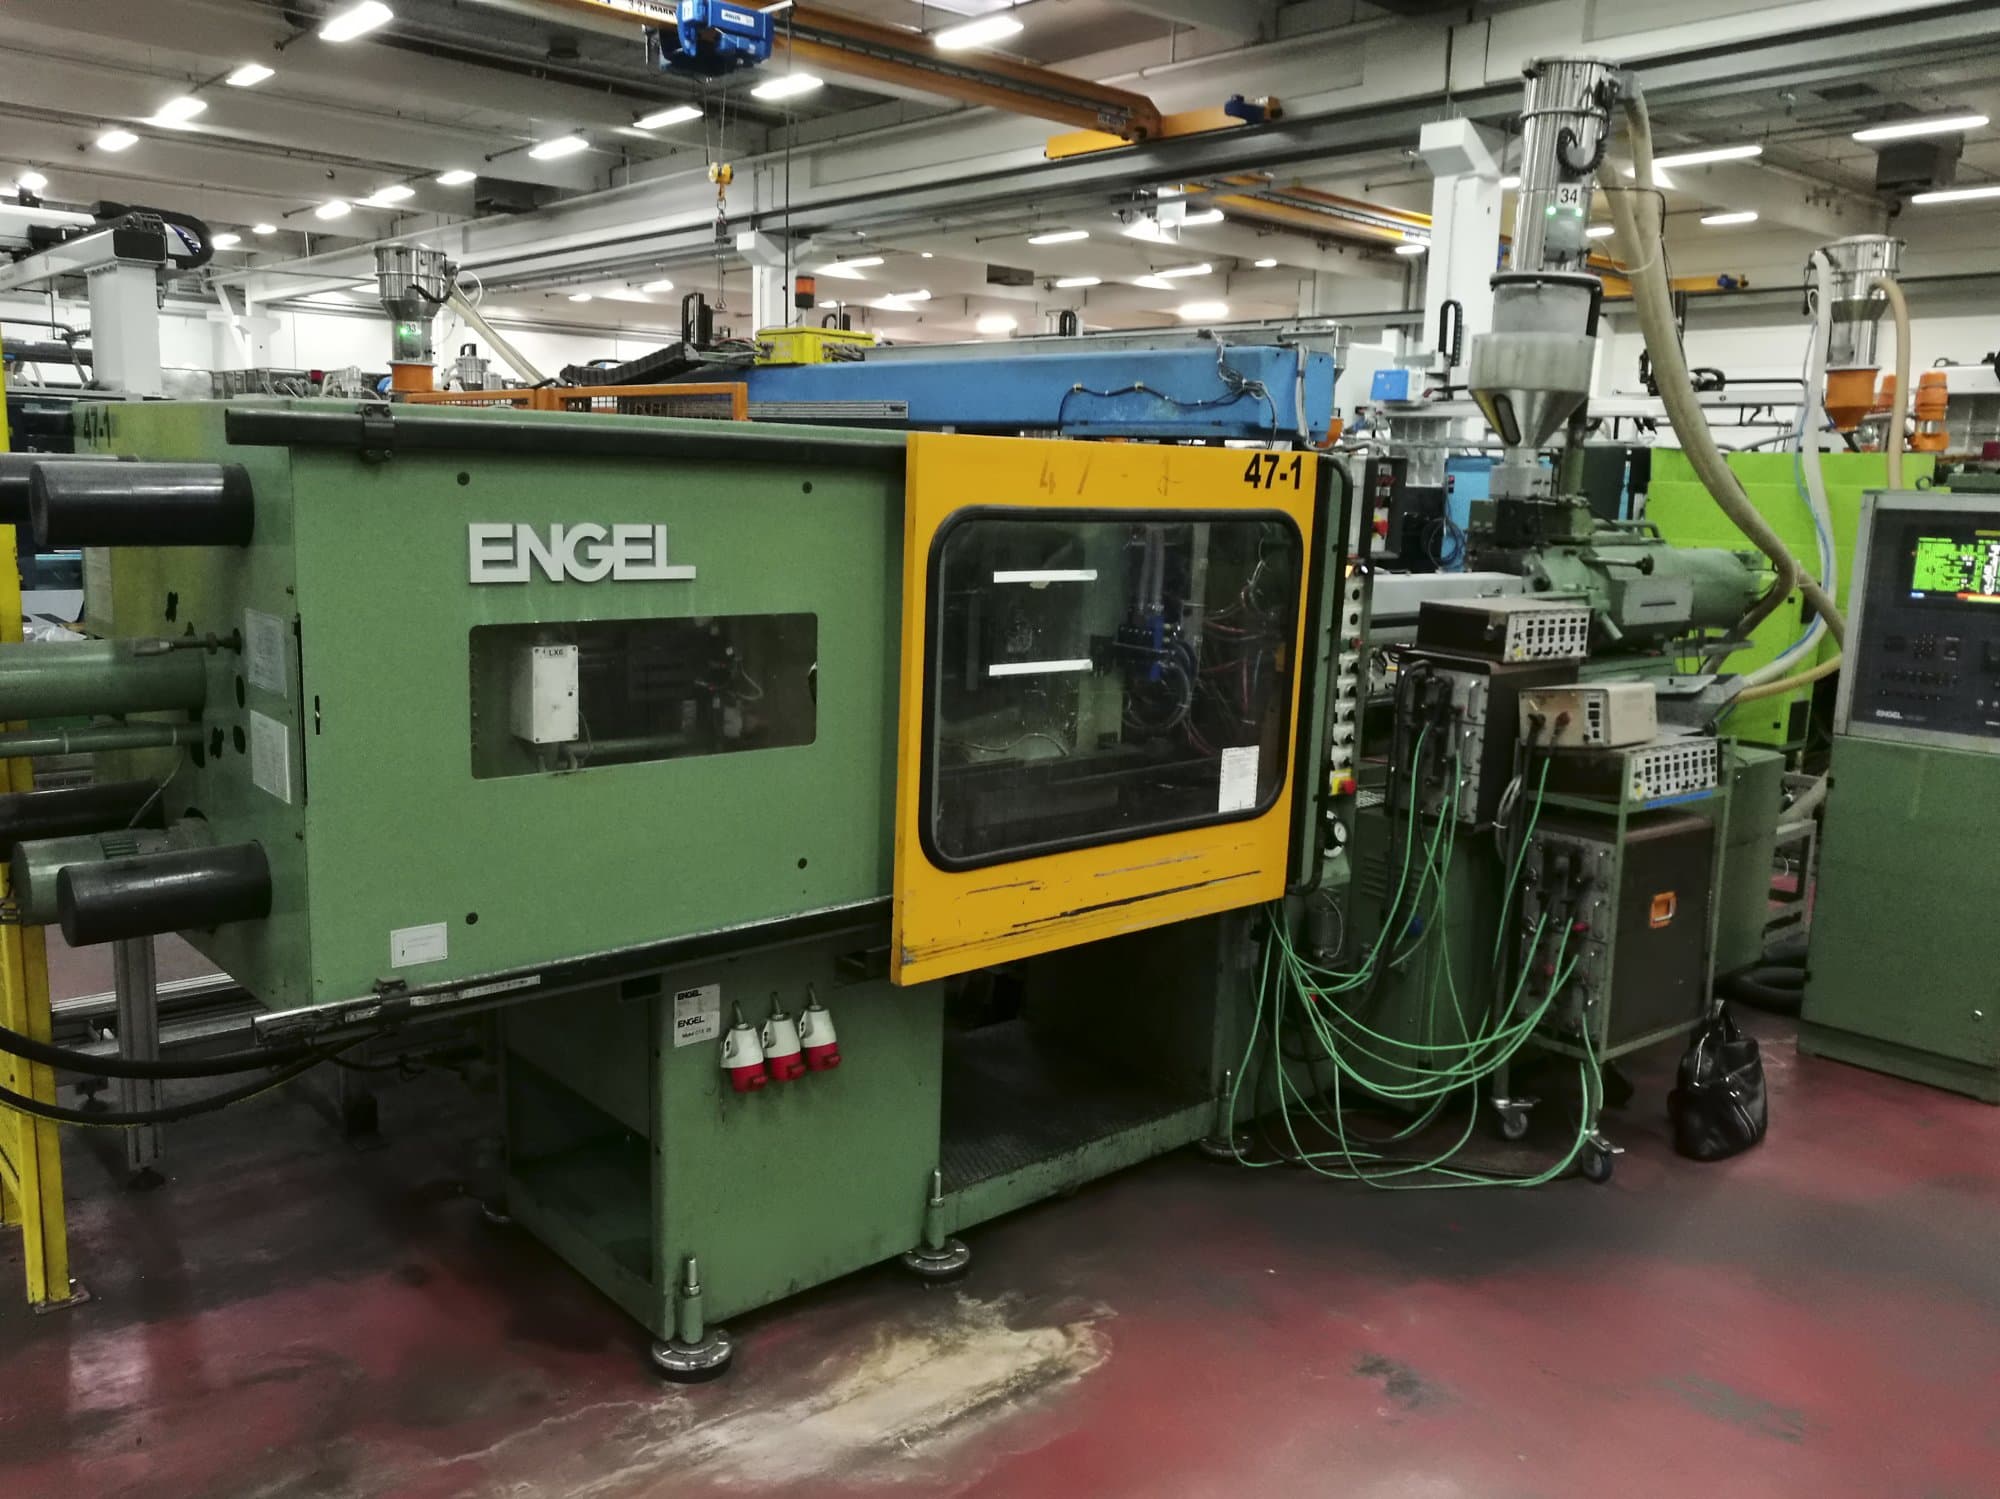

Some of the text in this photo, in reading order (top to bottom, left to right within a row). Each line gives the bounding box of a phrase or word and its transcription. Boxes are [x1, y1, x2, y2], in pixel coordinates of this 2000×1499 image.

[1560, 187, 1578, 204] 34
[1244, 453, 1302, 490] 47-1
[469, 522, 697, 583] ENGEL
[678, 1016, 705, 1028] ENGEL
